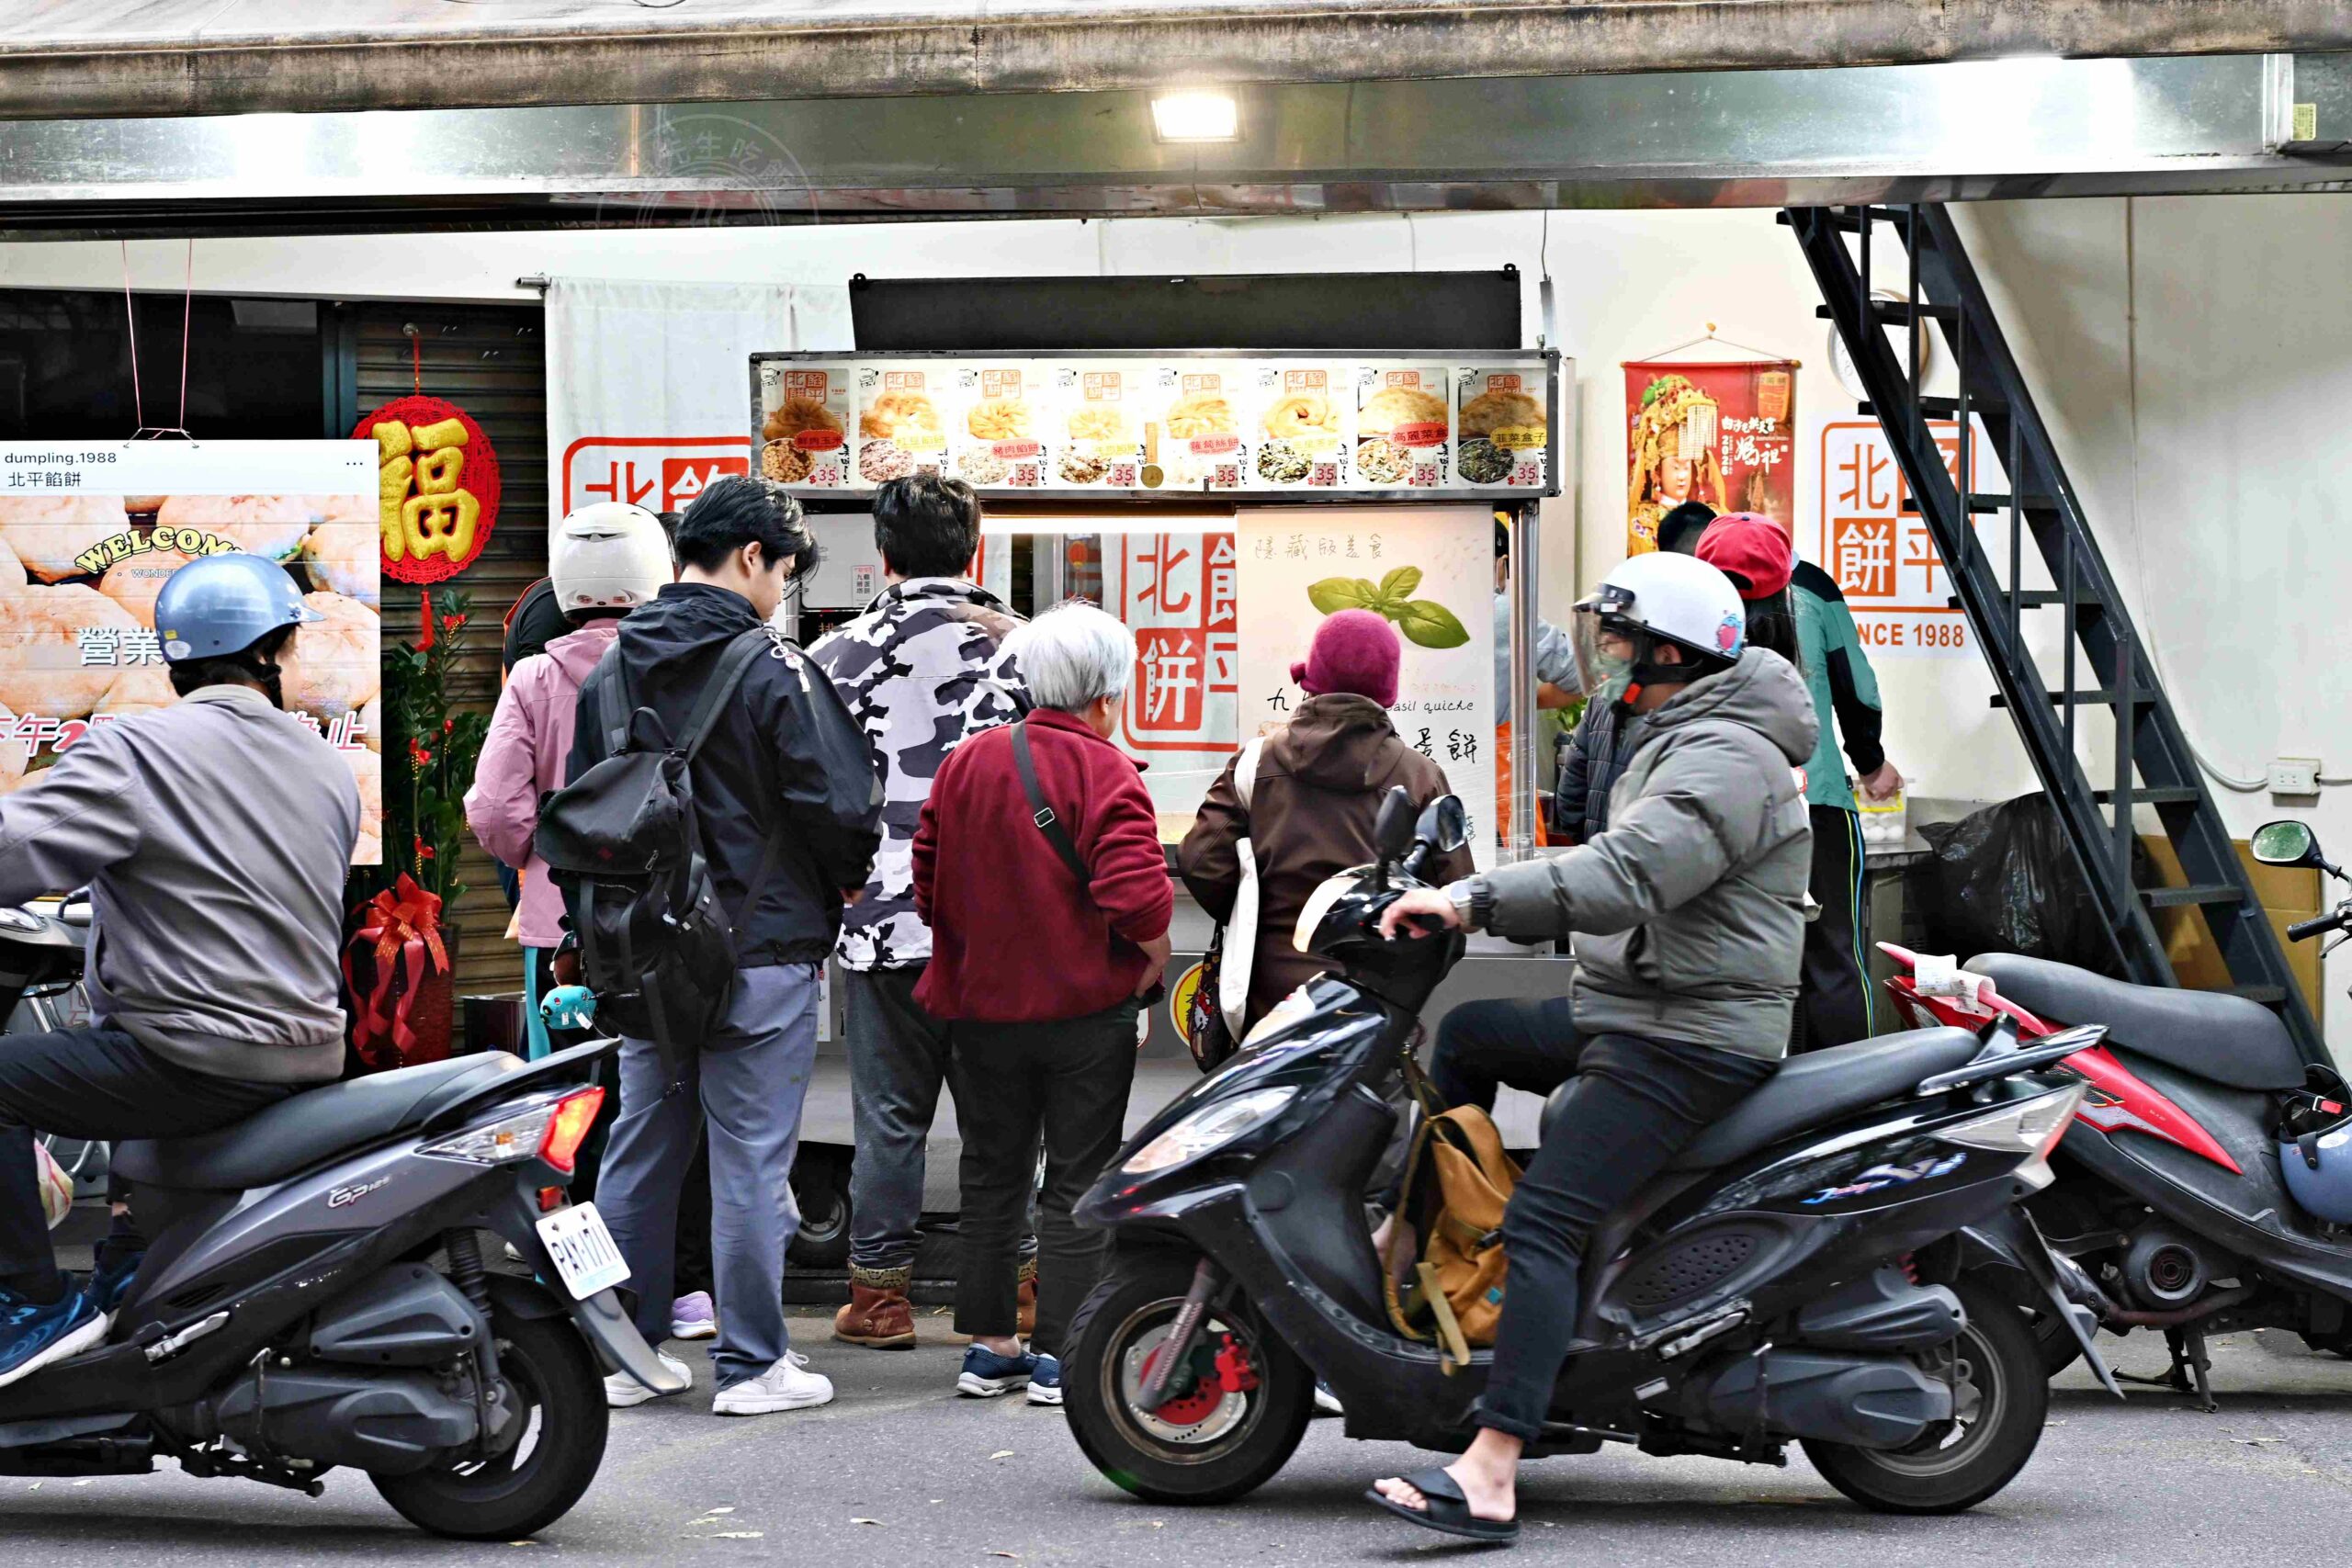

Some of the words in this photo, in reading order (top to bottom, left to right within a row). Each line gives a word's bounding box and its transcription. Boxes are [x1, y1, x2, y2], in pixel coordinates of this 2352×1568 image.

[1497, 432, 1545, 443] 韭菜盒子
[5, 452, 118, 467] dumpling.1988
[1721, 435, 1729, 476] 2026
[7, 471, 82, 488] 北平餡餅
[819, 468, 835, 481] 35
[1018, 468, 1035, 481] 35
[1114, 468, 1132, 481] 35
[1217, 469, 1236, 482] 35
[1317, 468, 1334, 480] 35
[1418, 468, 1436, 481] 35
[1519, 467, 1536, 479] 35
[372, 417, 481, 562] 福
[74, 525, 243, 575] WELCOM
[1858, 624, 1904, 647] NCE
[1913, 624, 1964, 648] 1988
[1424, 700, 1474, 715] quiche
